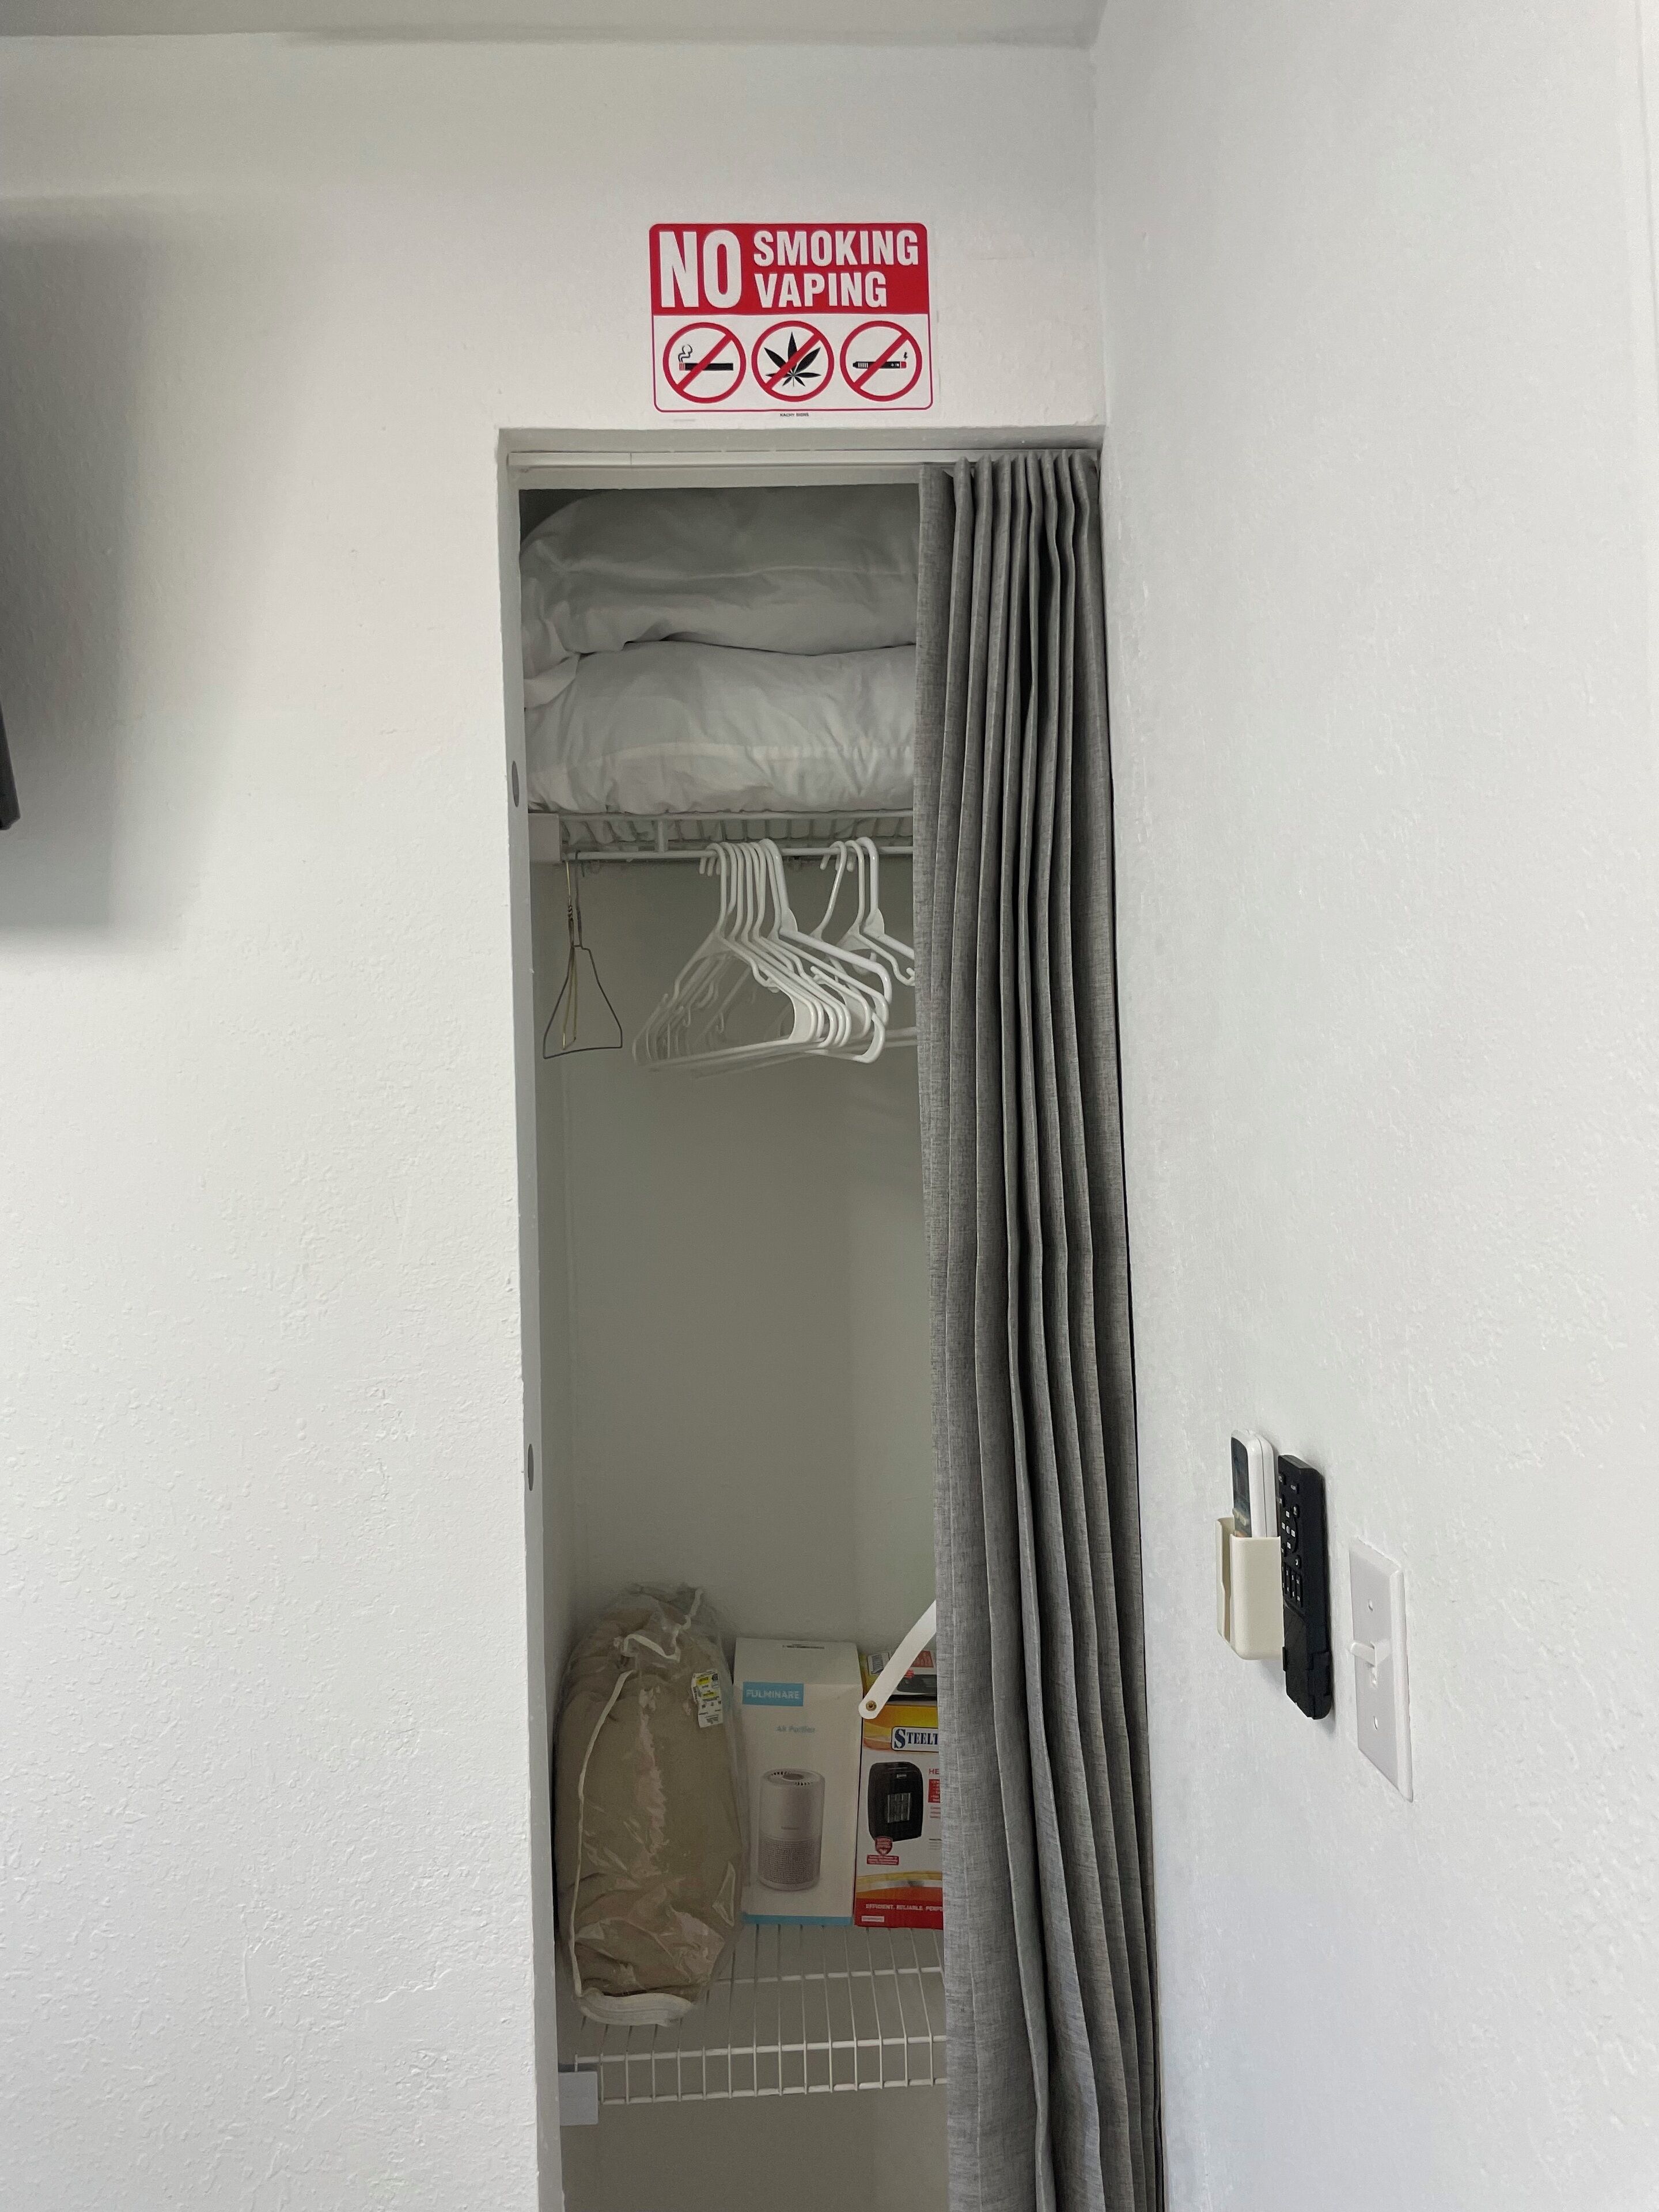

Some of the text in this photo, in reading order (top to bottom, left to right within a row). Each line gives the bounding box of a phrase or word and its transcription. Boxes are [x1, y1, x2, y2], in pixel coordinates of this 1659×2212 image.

[753, 229, 918, 267] SMOKING
[659, 230, 743, 309] NO
[754, 271, 887, 308] VAPING
